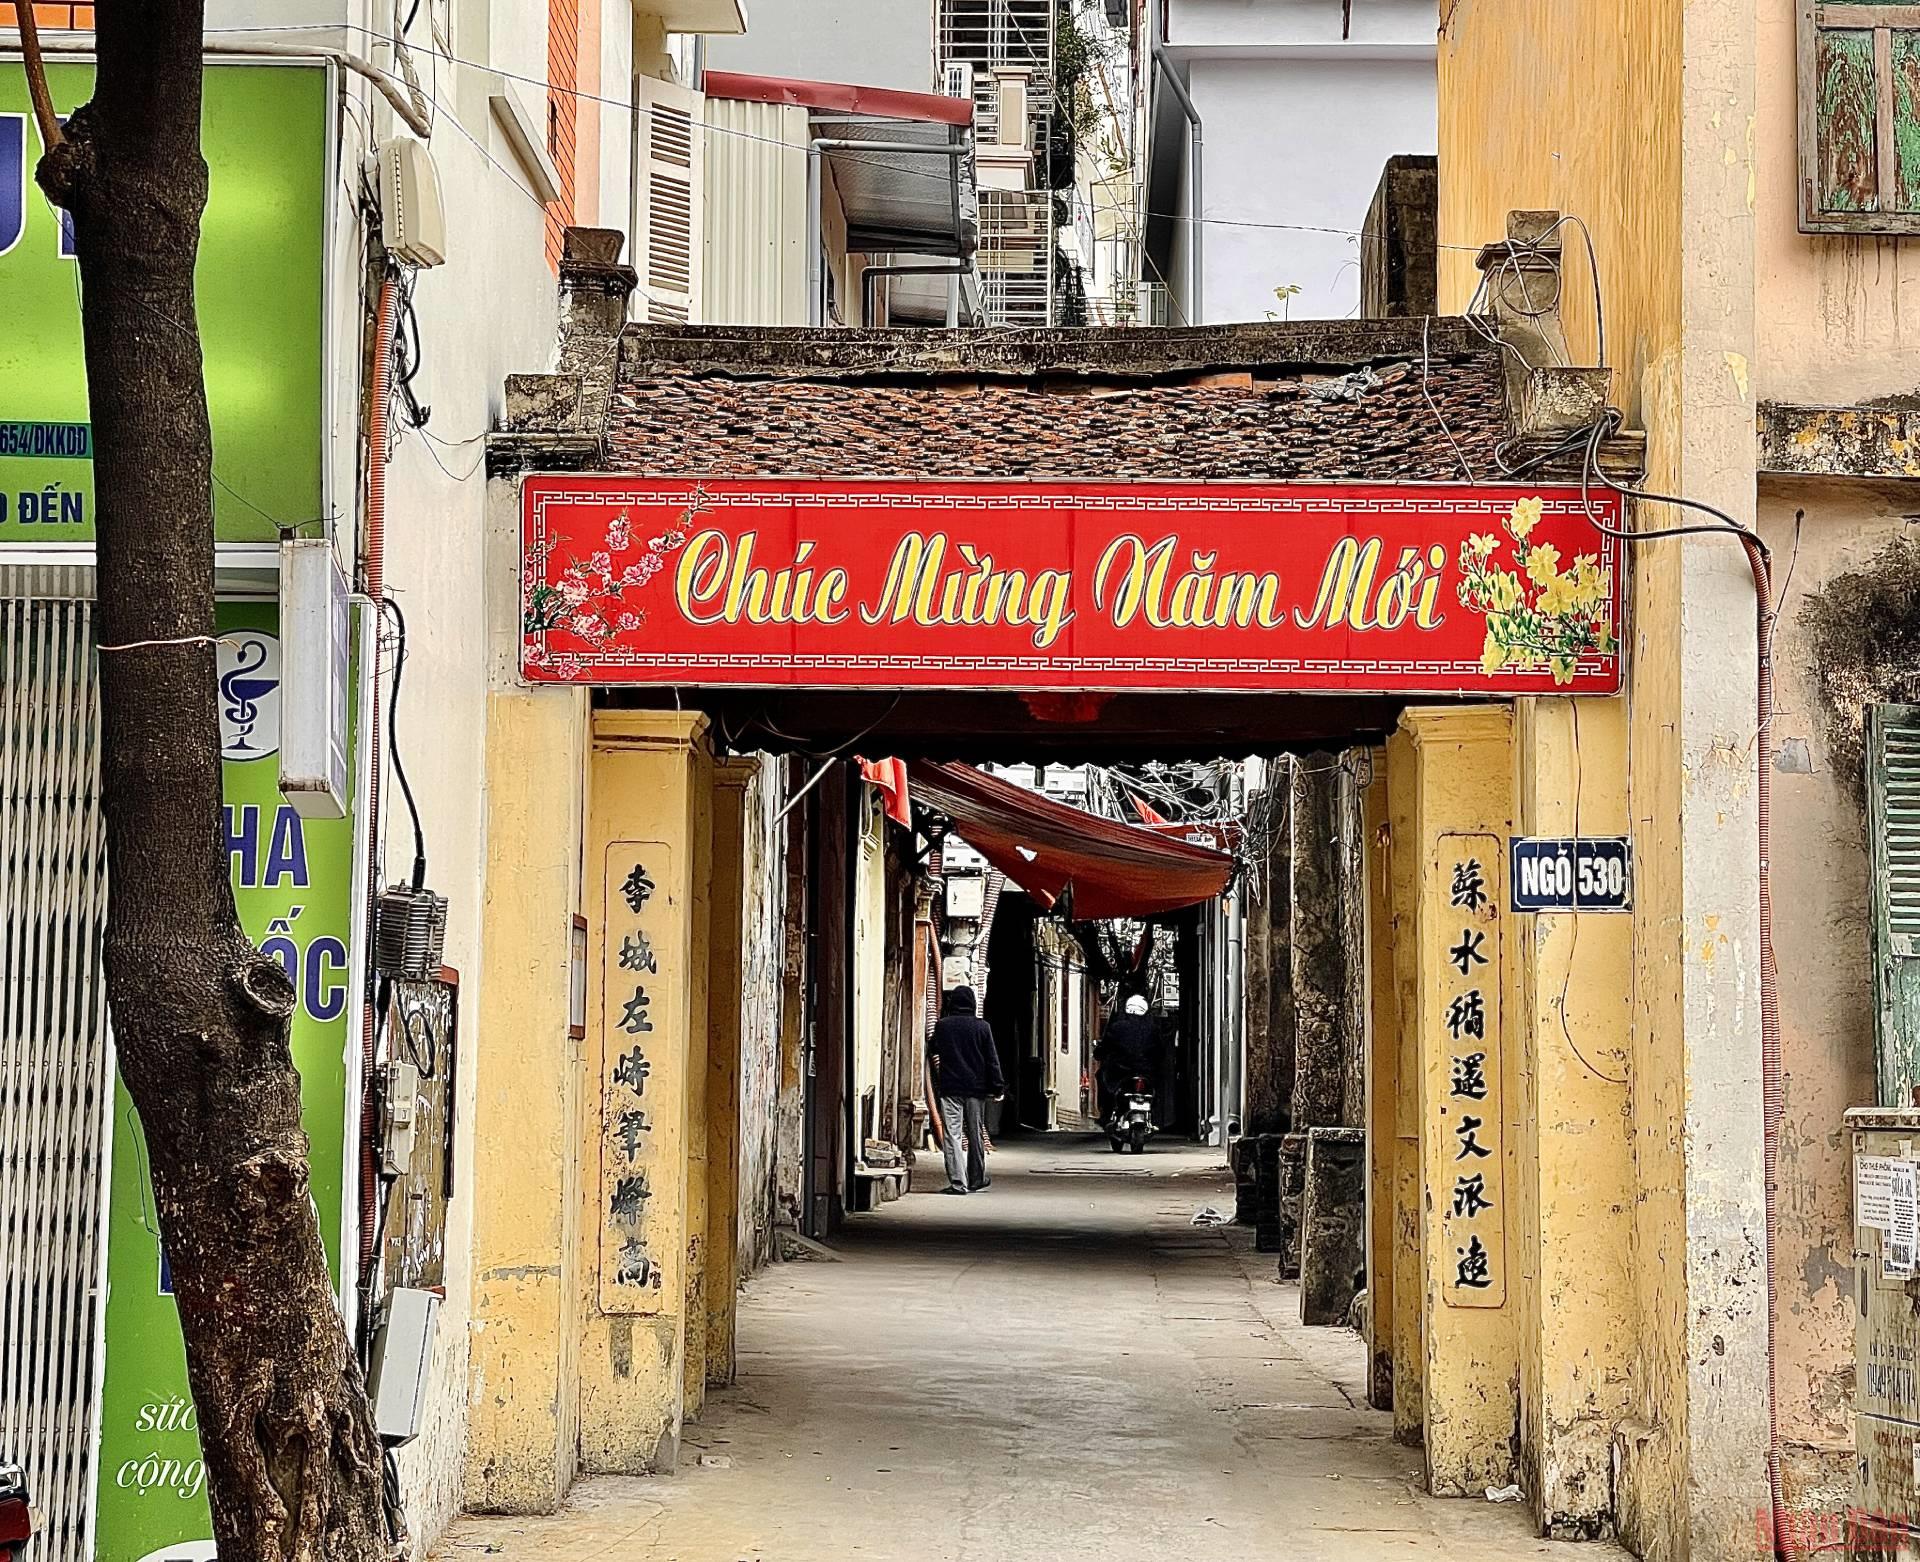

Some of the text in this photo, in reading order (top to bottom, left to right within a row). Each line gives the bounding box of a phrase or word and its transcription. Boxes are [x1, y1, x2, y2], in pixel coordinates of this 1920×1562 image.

[18, 482, 83, 523] ĐẾN
[675, 528, 1446, 648] Chúc Mừng Năm Mới
[1521, 848, 1623, 896] NGÕ 530
[116, 1452, 206, 1498] cộng
